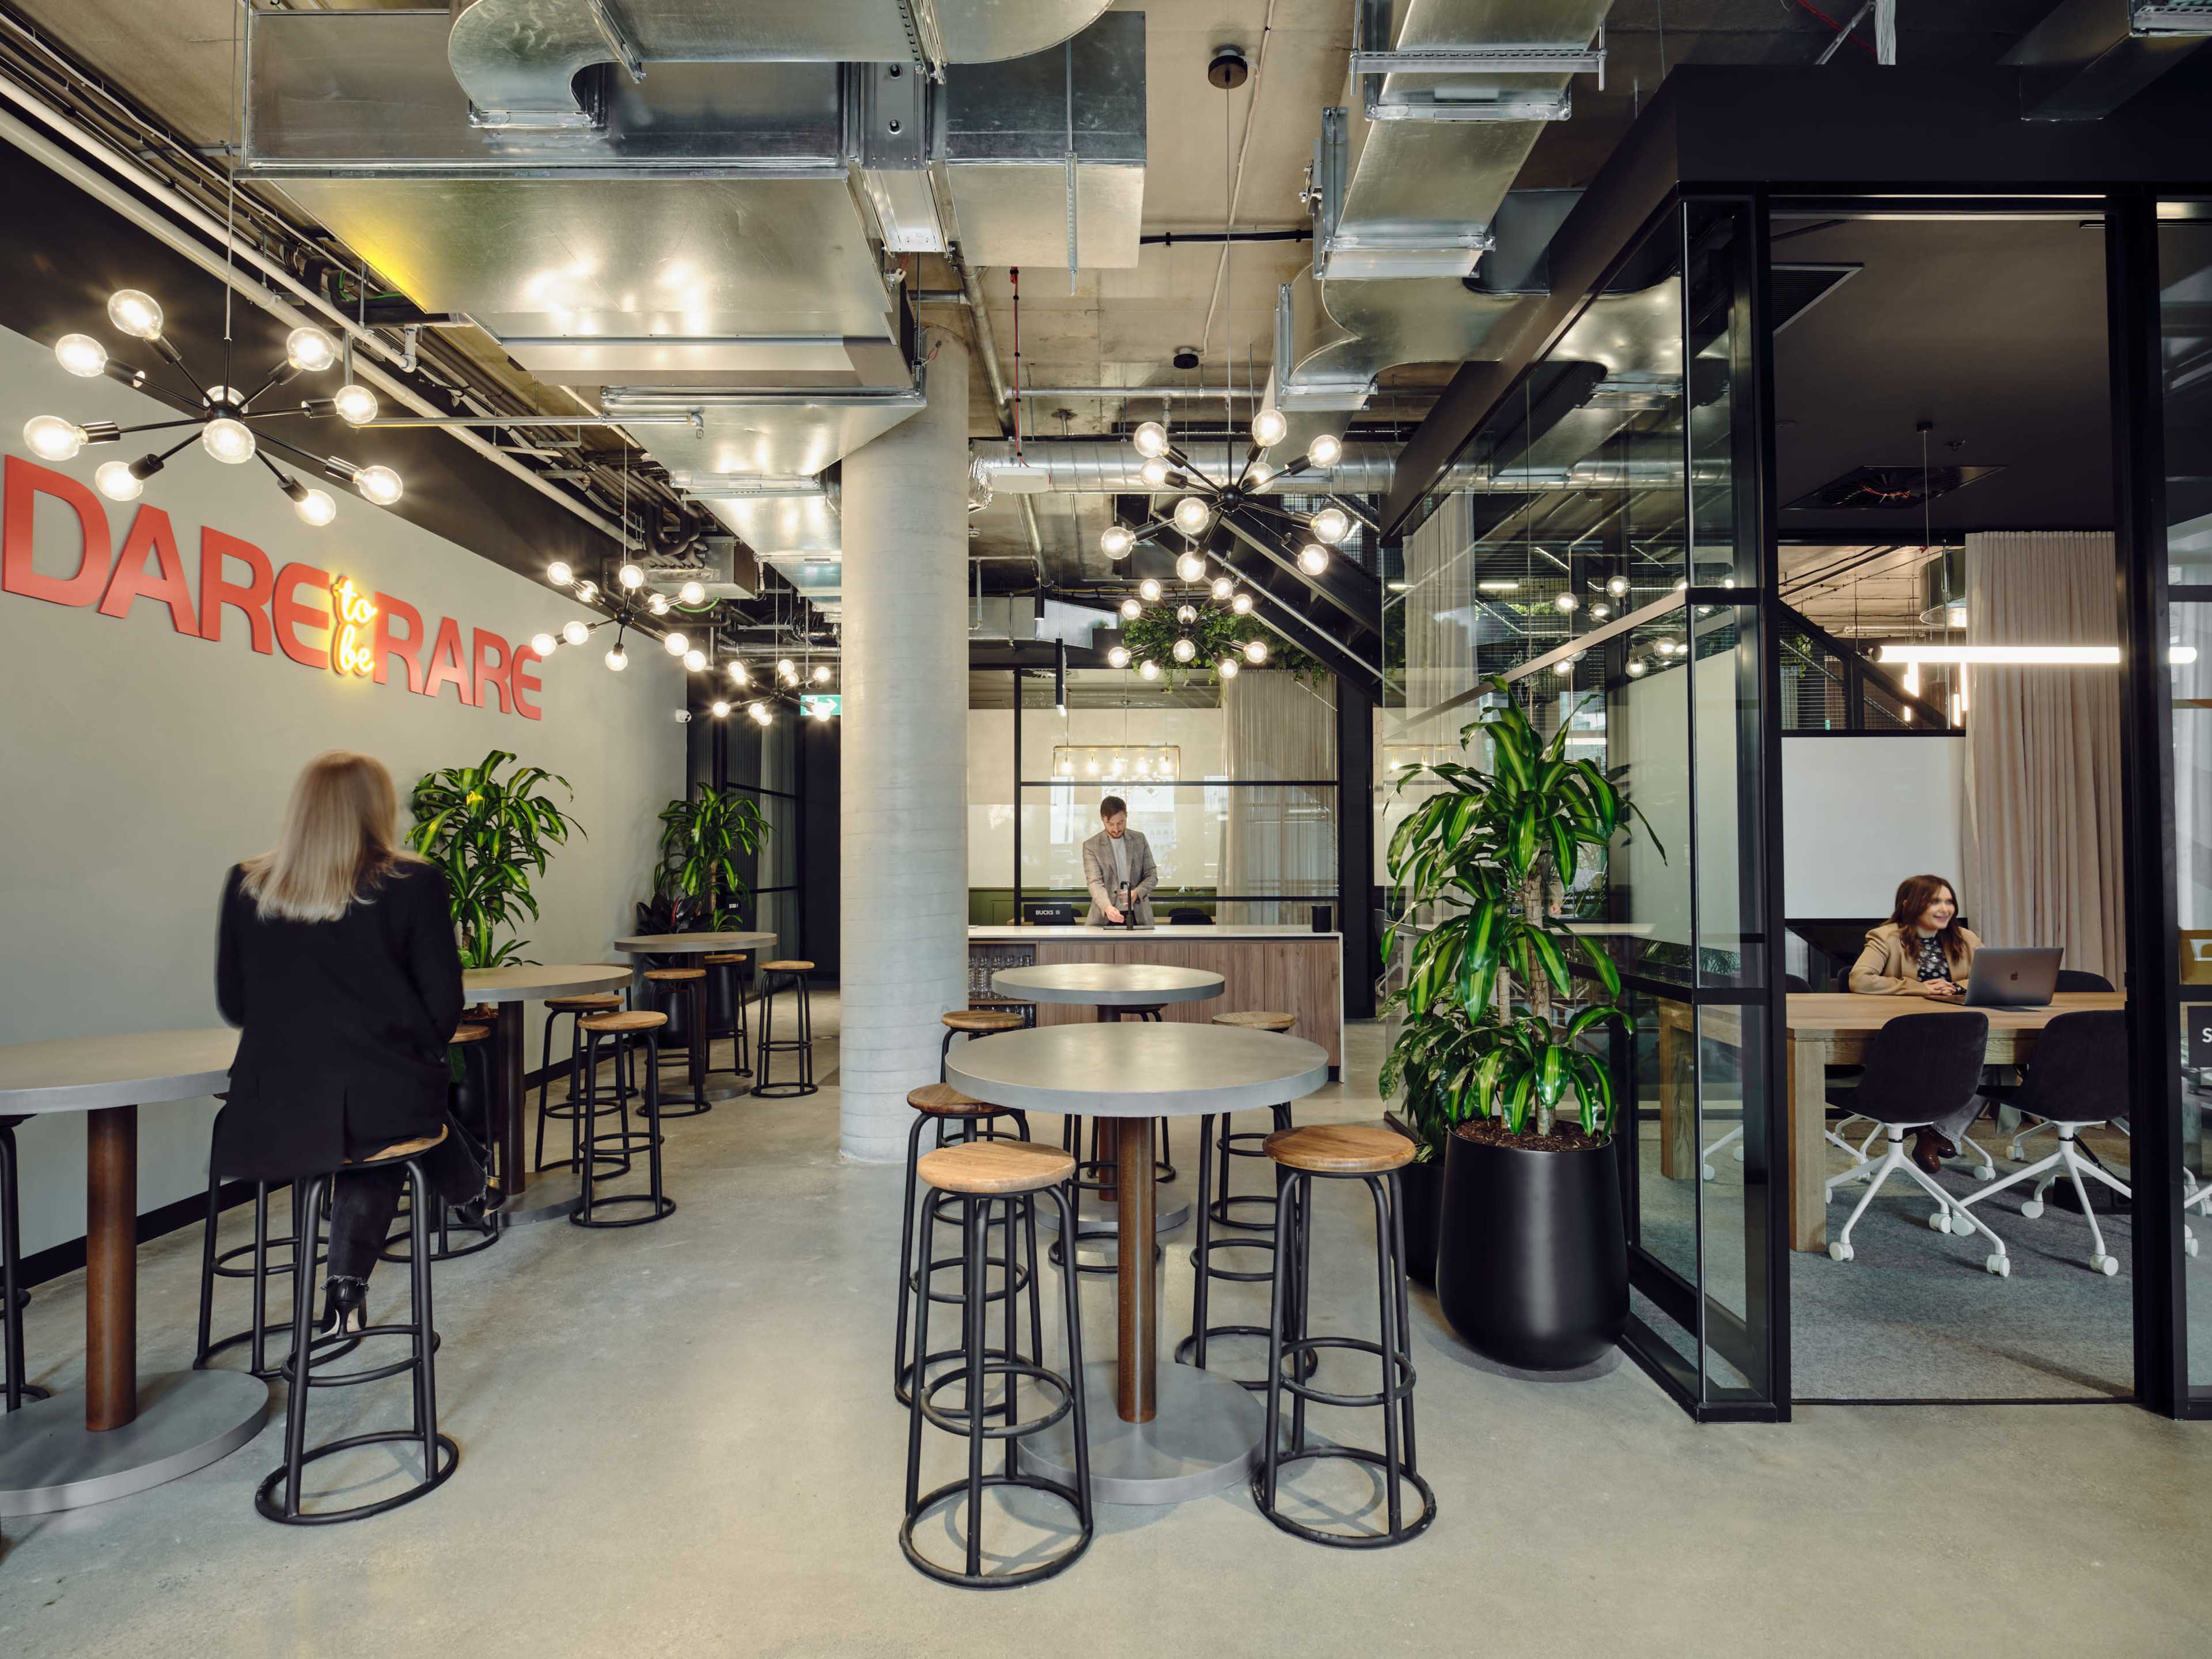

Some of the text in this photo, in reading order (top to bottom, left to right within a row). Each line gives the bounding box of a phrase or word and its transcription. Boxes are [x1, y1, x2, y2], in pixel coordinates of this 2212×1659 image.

[2, 454, 541, 721] DARE to be RARE
